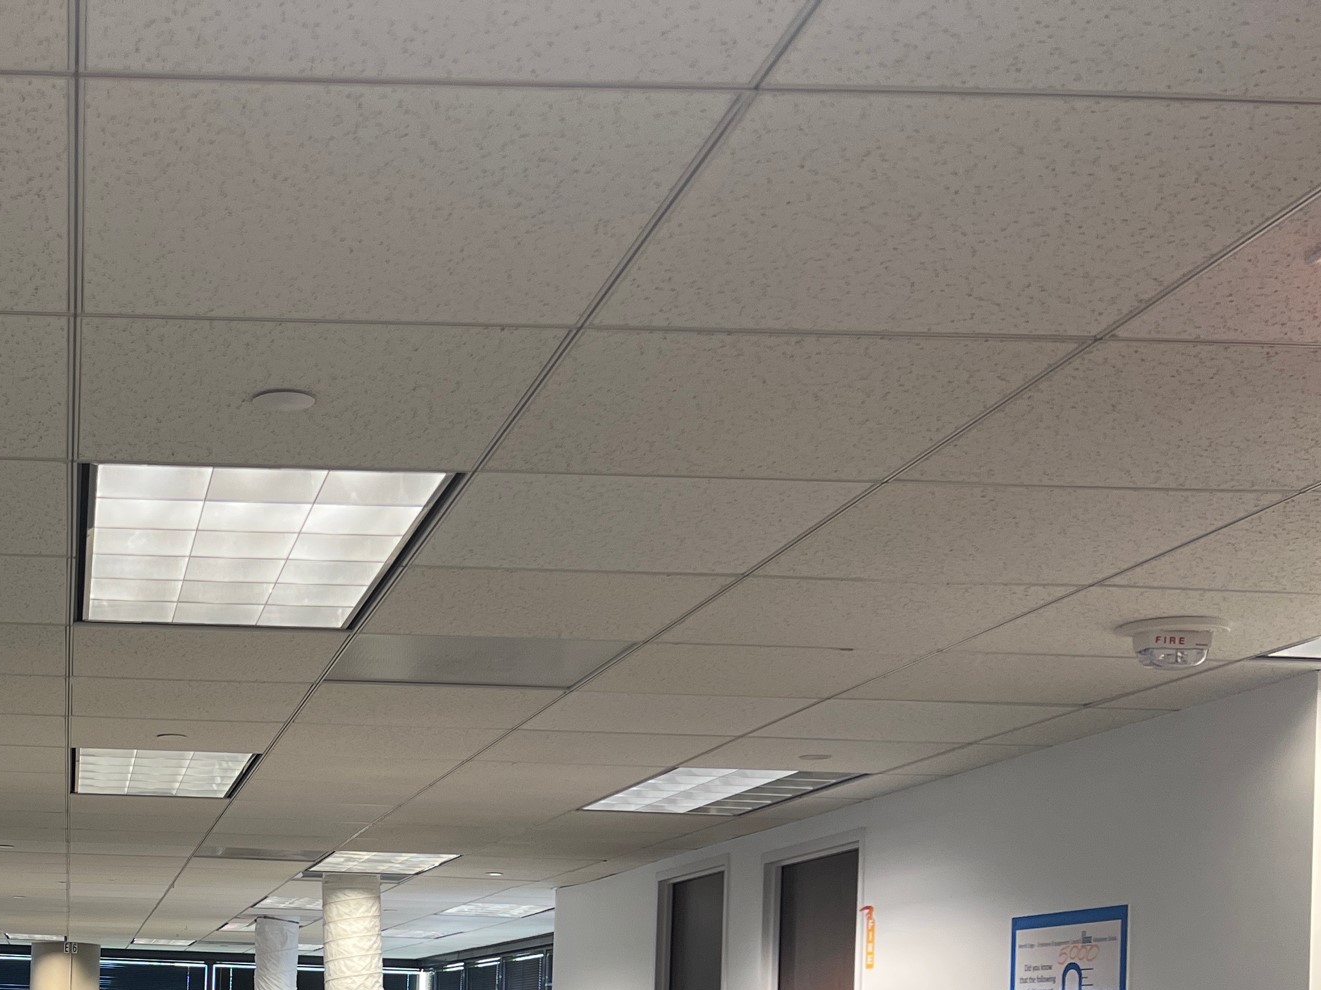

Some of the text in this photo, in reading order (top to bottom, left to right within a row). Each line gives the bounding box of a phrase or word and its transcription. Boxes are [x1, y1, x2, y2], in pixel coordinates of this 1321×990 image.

[1155, 635, 1185, 645] FIRE
[867, 919, 875, 965] FIRE
[1058, 944, 1099, 966] 5000
[1036, 975, 1056, 984] following
